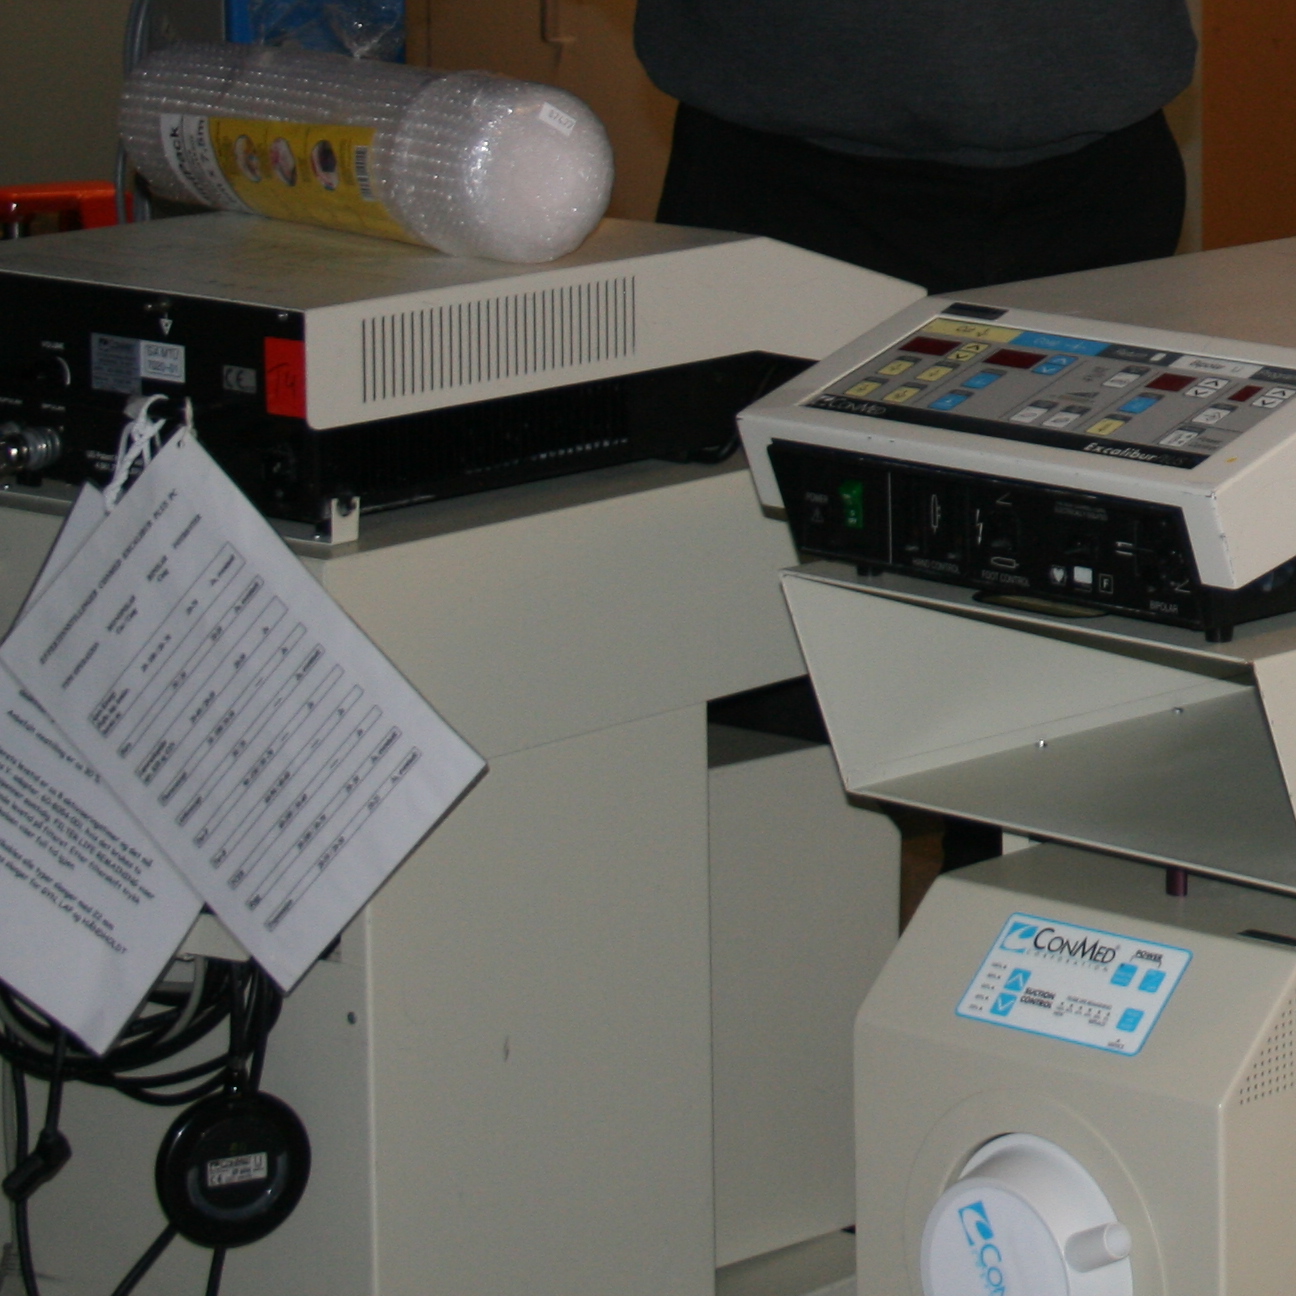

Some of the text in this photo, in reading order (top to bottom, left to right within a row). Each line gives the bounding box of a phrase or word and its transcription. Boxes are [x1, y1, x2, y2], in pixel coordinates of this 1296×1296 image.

[1083, 441, 1160, 462] Excalibur
[1134, 949, 1163, 962] POWER
[1024, 986, 1056, 1000] SUCTION
[1019, 994, 1053, 1009] CONTROL
